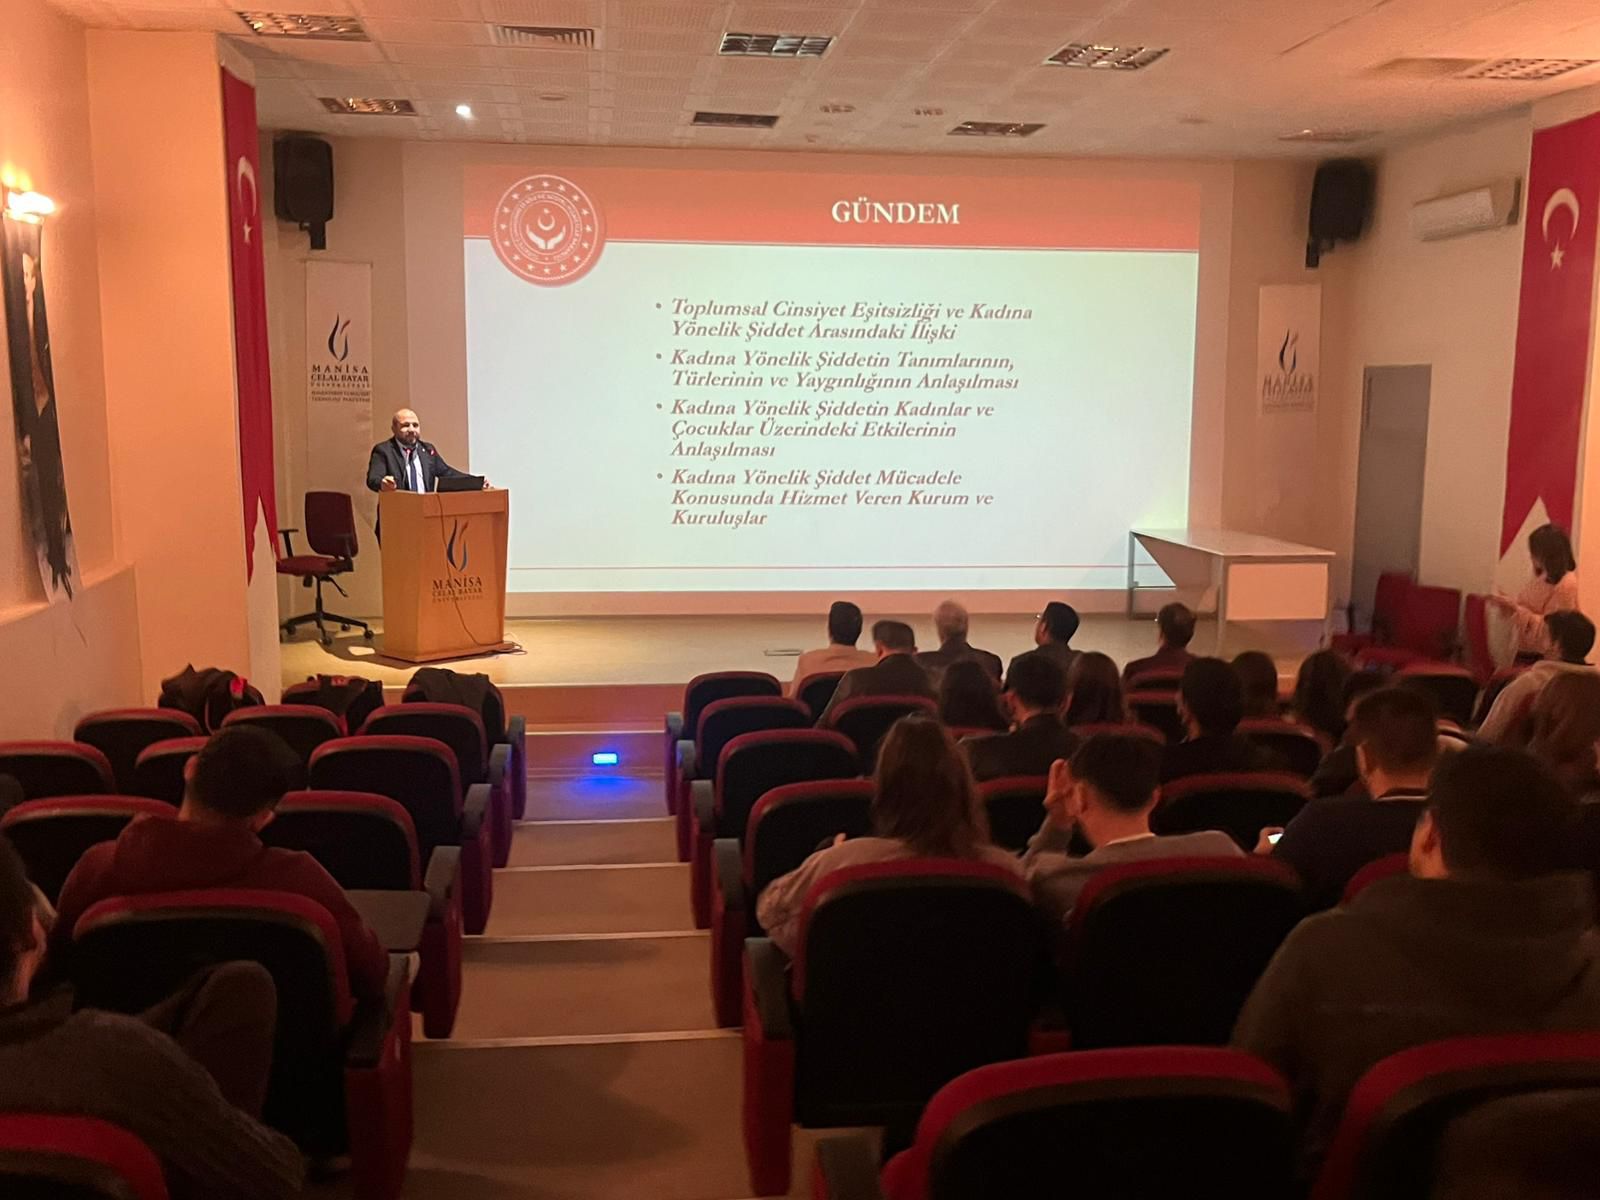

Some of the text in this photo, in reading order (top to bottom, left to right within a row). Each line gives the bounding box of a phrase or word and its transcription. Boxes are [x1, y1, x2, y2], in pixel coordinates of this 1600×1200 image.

[831, 196, 960, 224] GÜNDEM
[672, 298, 1032, 322] Toplumsal Cinsiyet Eşitsizliği ve Kadına
[672, 320, 958, 344] Yönelik Şiddet Arasındaki İlişki
[312, 364, 368, 373] MANİSA
[670, 349, 1014, 371] Kadına Yönelik Şiddetin Tanımlarının,
[672, 369, 1019, 393] Türlerinin ve Yaygınlığının Anlaşılması
[670, 399, 994, 420] Kadına Yönelik Şiddetin Kadınlar ve
[671, 417, 956, 440] Çocuklar Üzerindeki Etkilerinin
[670, 441, 776, 461] Anlaşılması
[671, 469, 962, 489] Kadına Yönelik Şiddet Mücadele
[671, 489, 994, 505] Konusunda Hizmet Veren Kurum ve
[671, 509, 767, 529] Kuruluşlar
[432, 575, 482, 590] MANİSA
